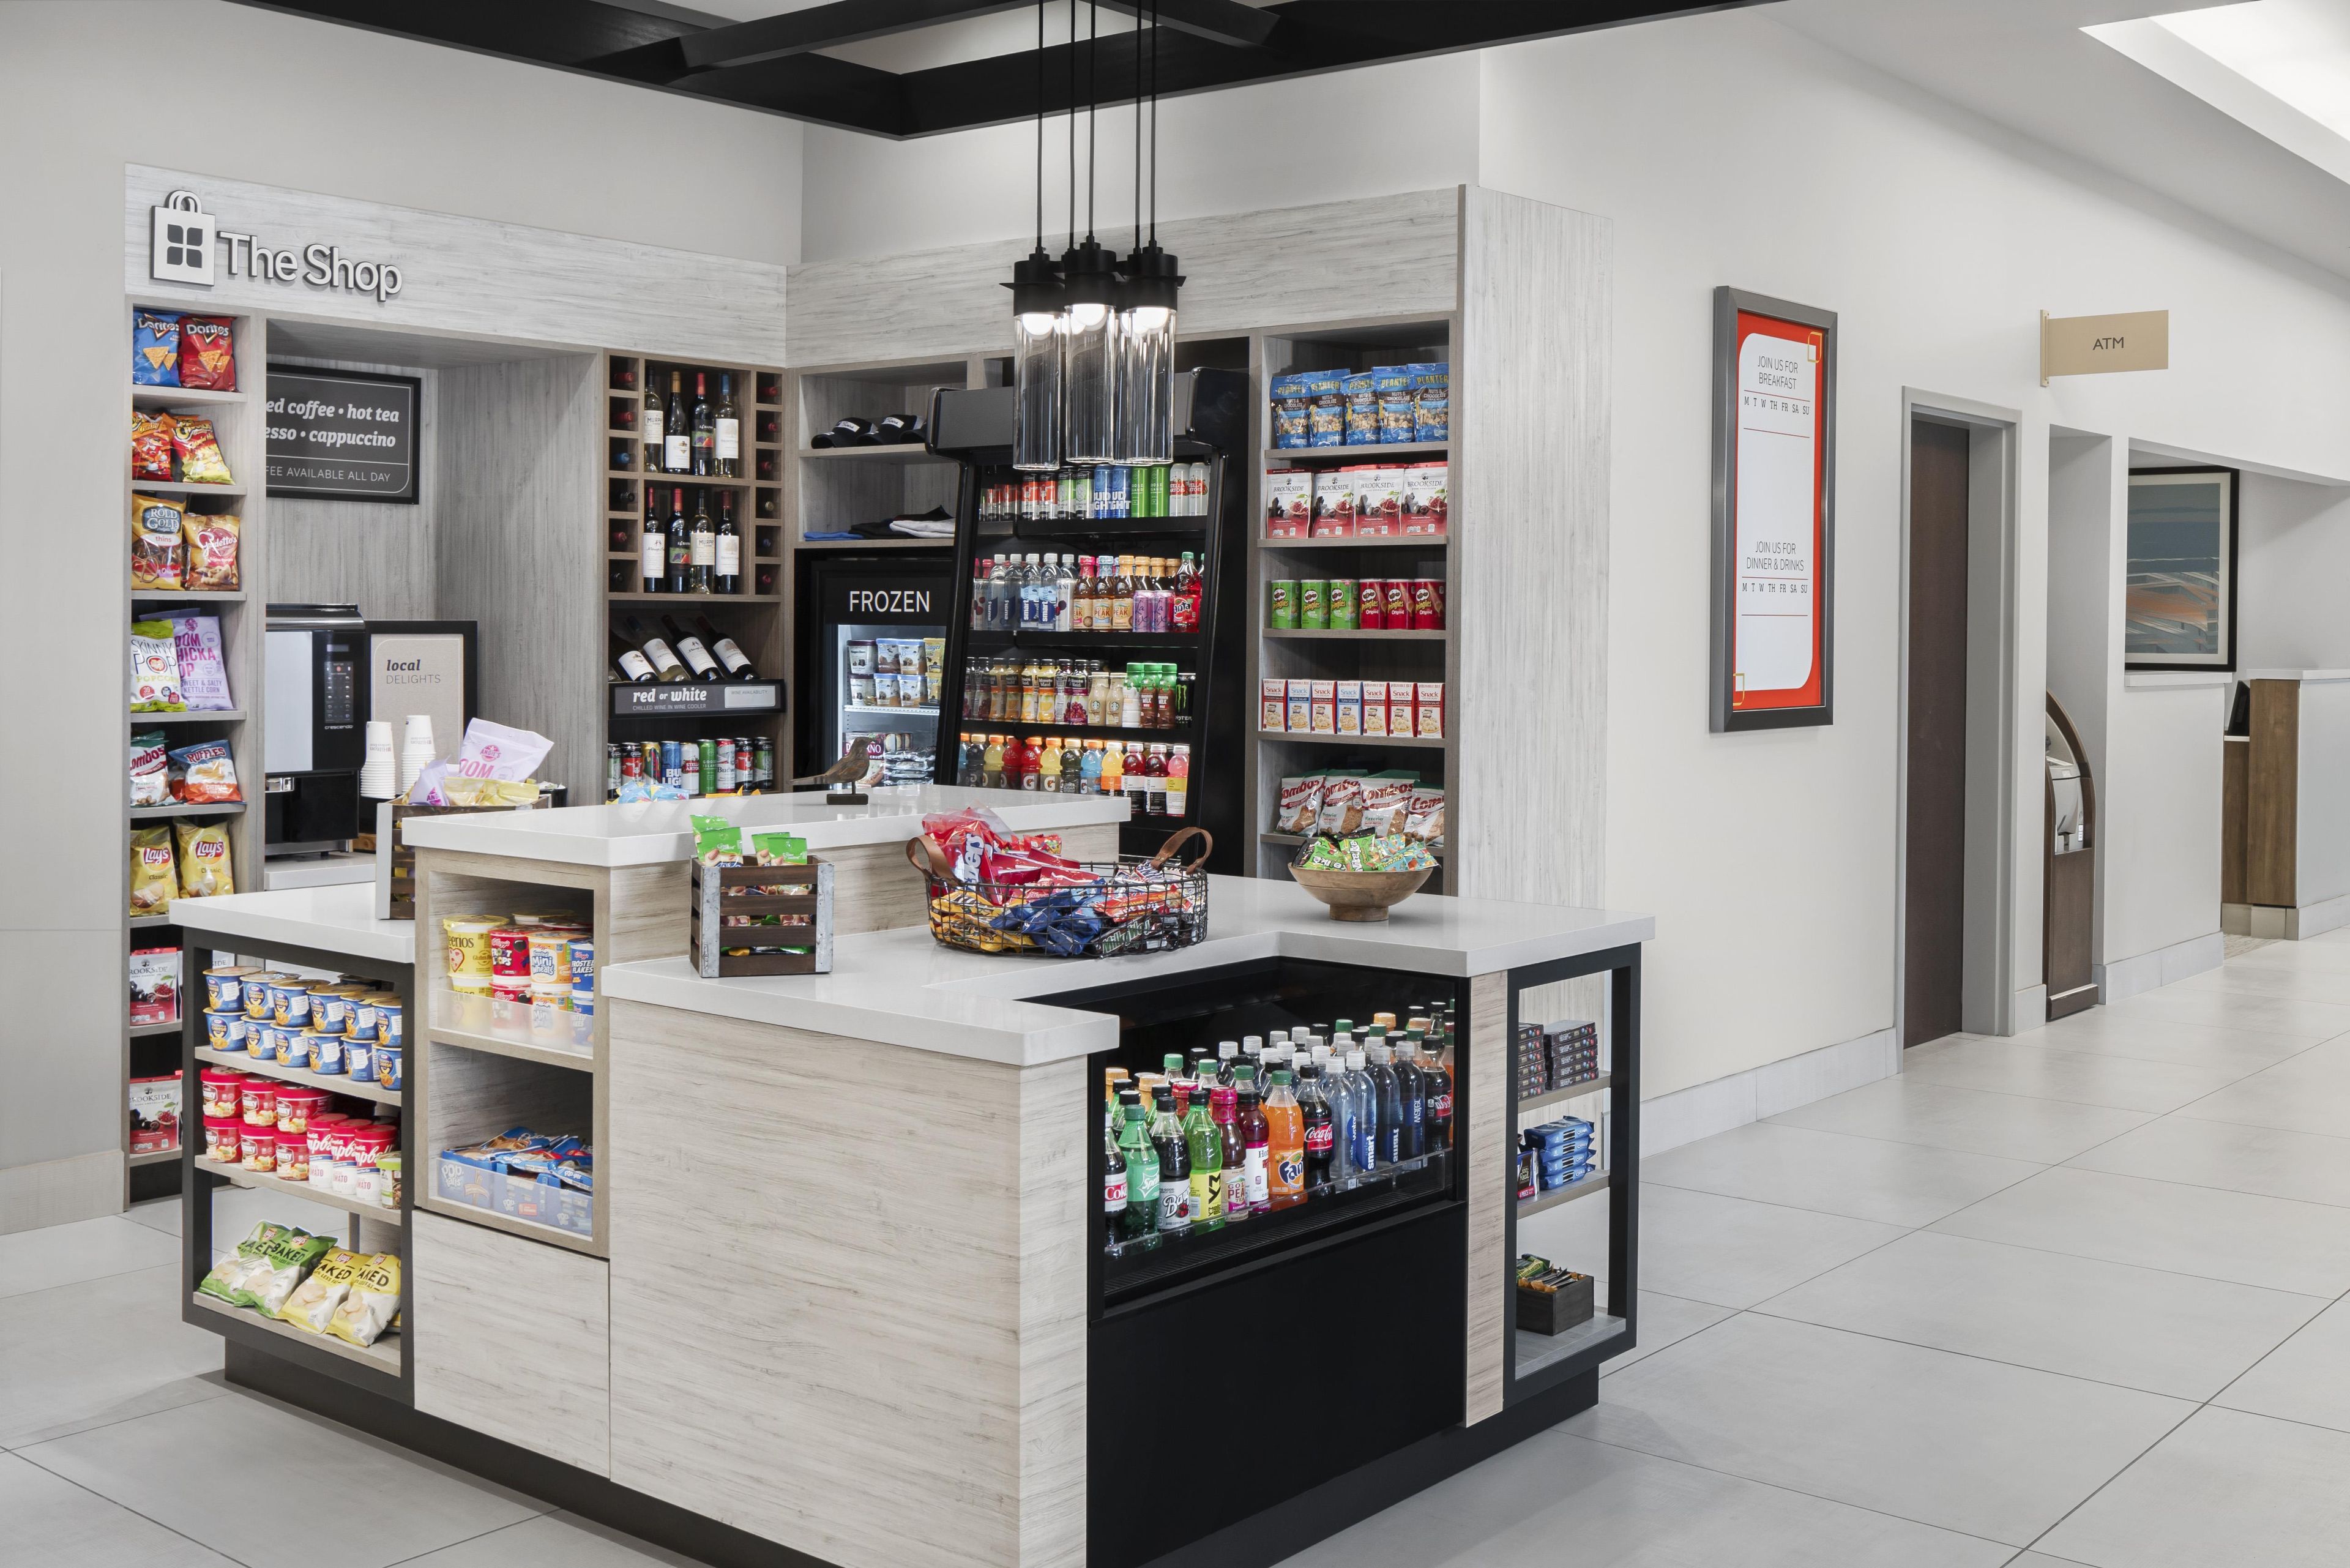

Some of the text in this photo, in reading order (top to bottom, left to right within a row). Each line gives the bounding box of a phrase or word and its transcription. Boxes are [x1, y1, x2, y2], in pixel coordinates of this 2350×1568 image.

[217, 230, 403, 302] The Shop
[186, 324, 229, 336] Doritos
[2093, 337, 2124, 350] ATM
[1758, 356, 1798, 373] JOIN US FOR
[1759, 372, 1797, 389] BREAKFAST
[288, 400, 335, 419] coffee
[347, 404, 373, 420] hot
[376, 408, 400, 422] tea
[1745, 396, 1810, 415] M T W TH FR SA SU
[309, 430, 396, 447] cappuccino
[286, 468, 345, 480] AVAILABLE
[348, 471, 367, 481] ALL
[371, 472, 391, 482] DAY
[151, 509, 177, 519] ROLD
[147, 518, 179, 531] GOLD
[1756, 541, 1796, 554] JOIN US FOR
[1747, 557, 1804, 571] DINNER & DRINKS
[1743, 583, 1747, 591] M
[1759, 583, 1764, 592] W
[1780, 584, 1786, 592] FR
[1801, 584, 1807, 593] SU
[849, 591, 930, 612] FROZEN
[1273, 600, 1288, 610] Pringles
[1303, 602, 1320, 612] Pringles
[1331, 600, 1346, 610] Pringles
[1361, 600, 1378, 613] Pringles
[1388, 600, 1404, 613] Pringles
[1416, 600, 1431, 613] Pringles
[132, 639, 172, 655] SKINNY
[177, 648, 216, 662] HICKA
[133, 654, 176, 674] POP
[387, 659, 420, 671] local
[386, 674, 441, 684] DELIGHTS
[633, 689, 656, 703] red
[671, 687, 707, 701] white
[185, 747, 226, 764] RUFFLES
[1024, 775, 1035, 790] G
[1044, 775, 1055, 791] G
[145, 847, 170, 865] Lay's
[196, 842, 224, 857] Lay's
[1103, 930, 1129, 954] Milky
[532, 956, 553, 966] Mini
[533, 964, 554, 975] Wheats
[293, 1236, 308, 1246] Lay's
[275, 1243, 306, 1263] BAKED
[337, 1253, 353, 1264] Lay's
